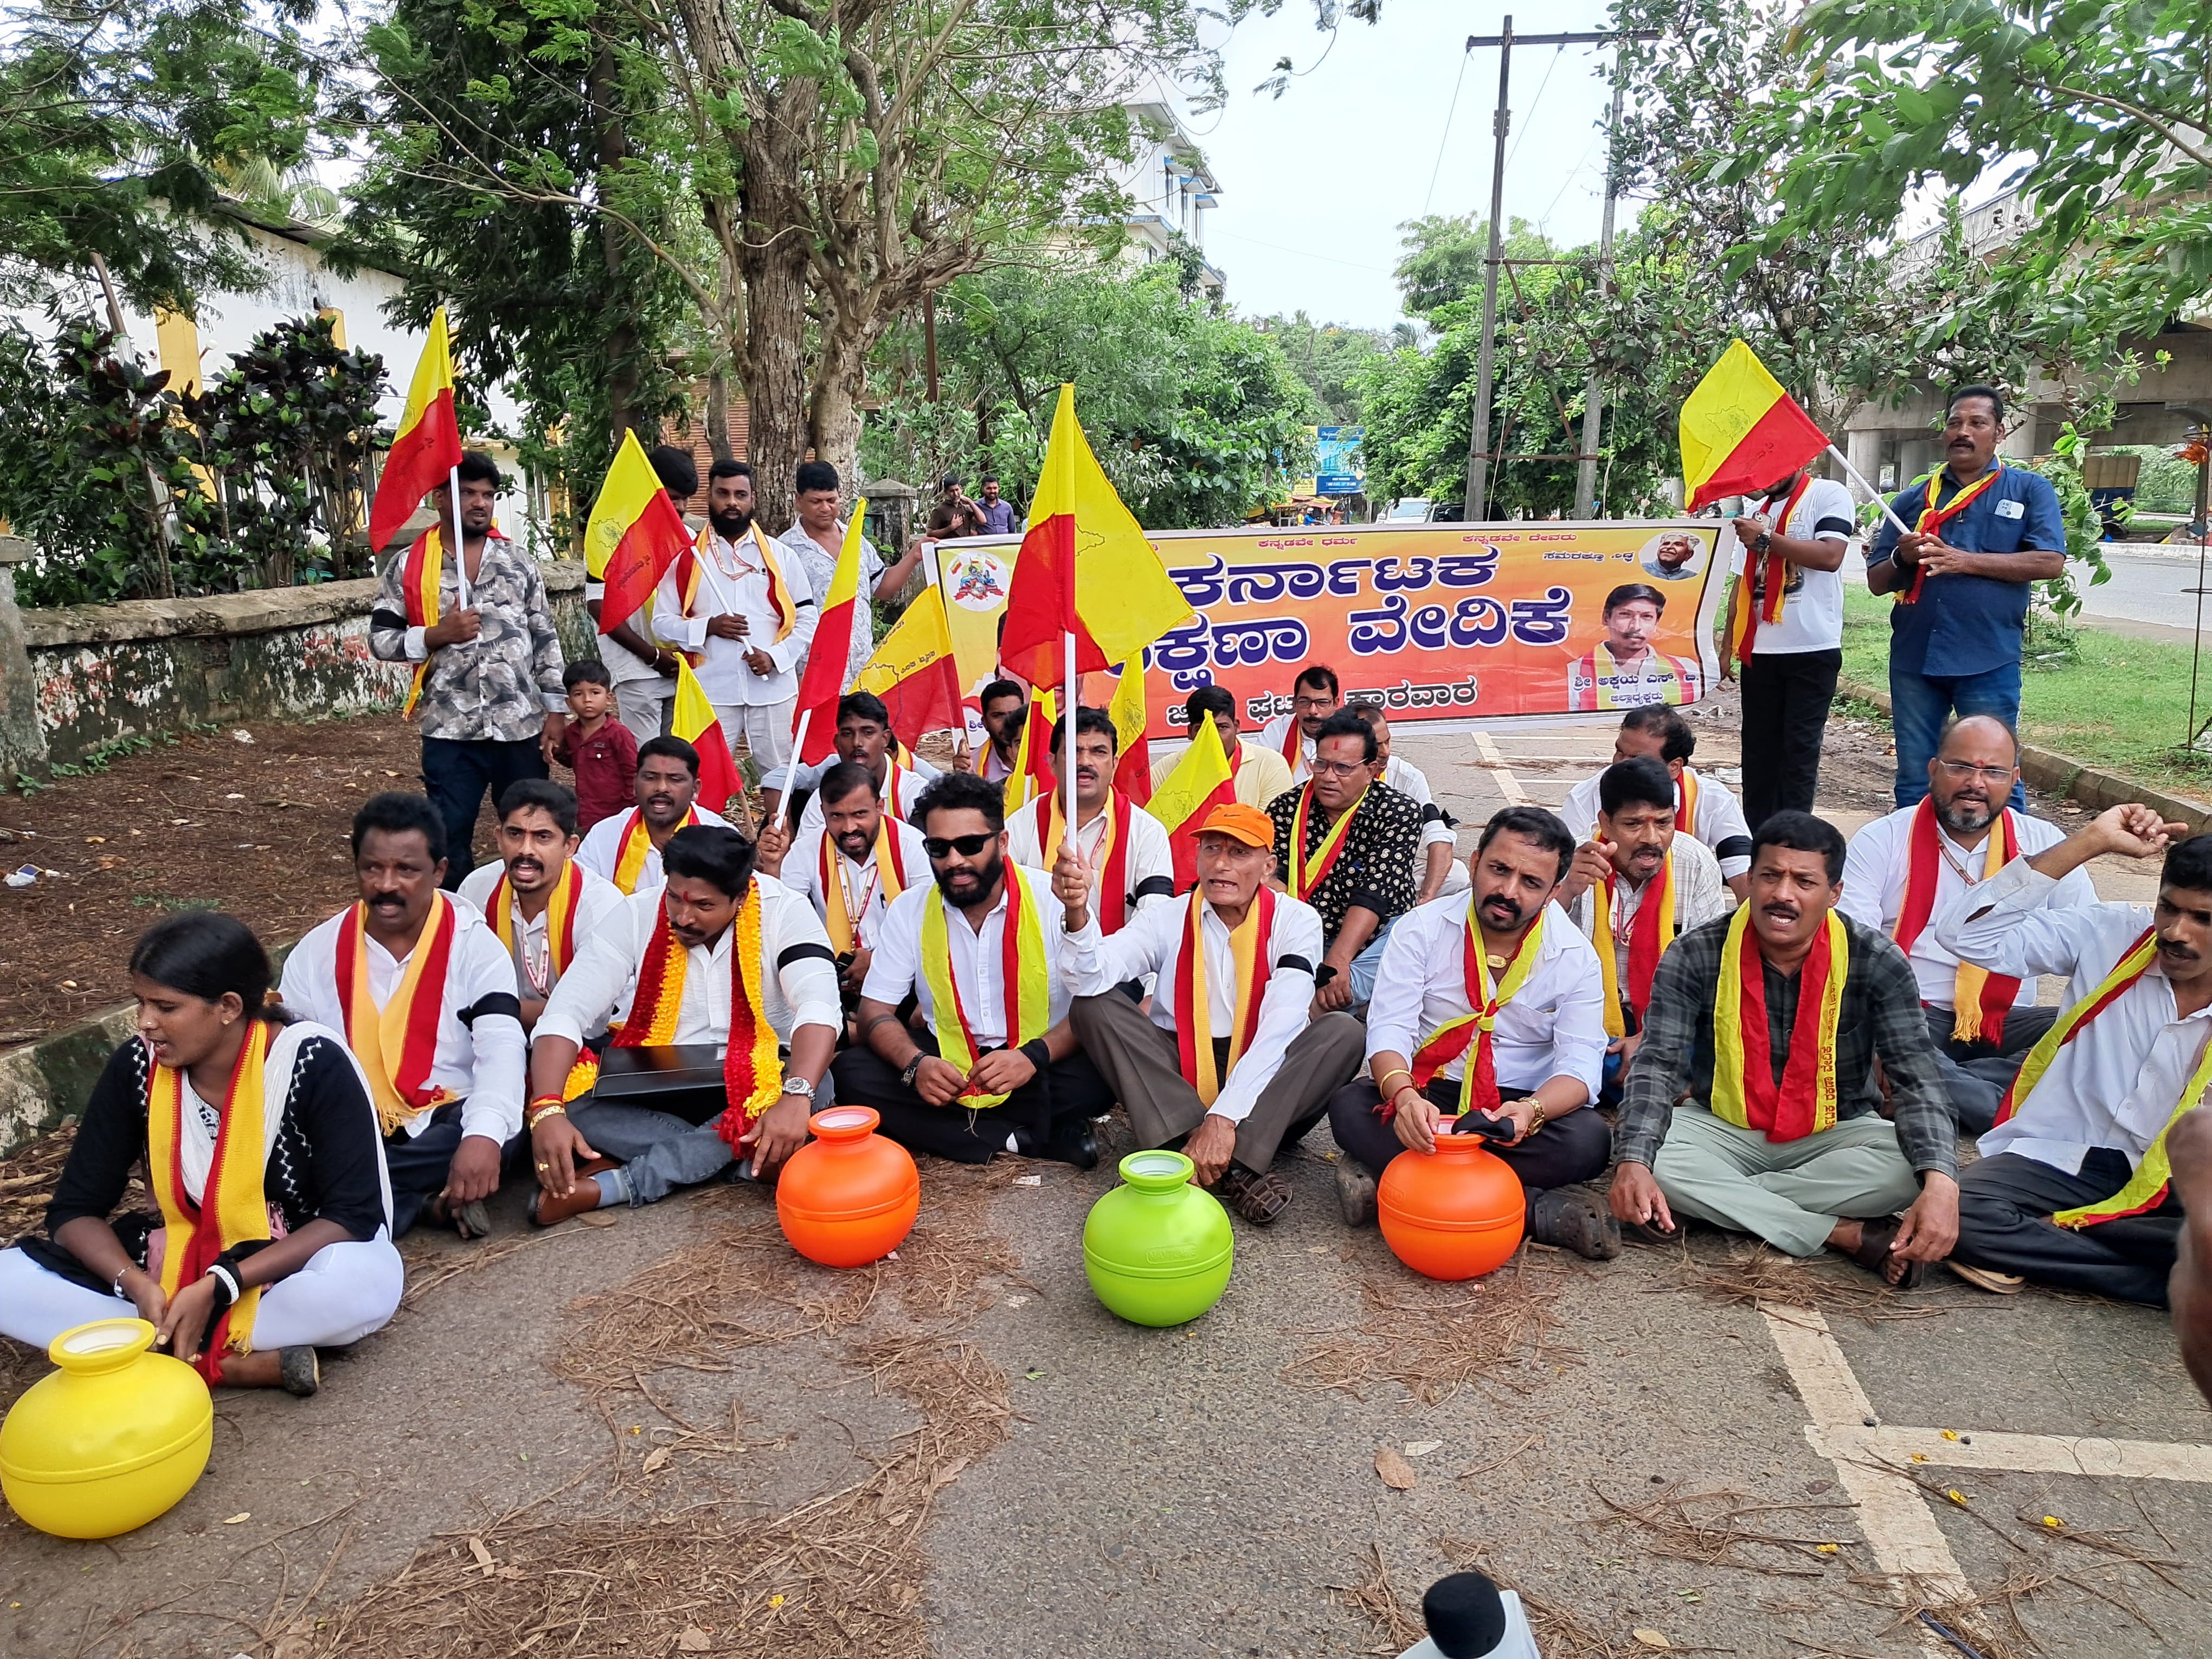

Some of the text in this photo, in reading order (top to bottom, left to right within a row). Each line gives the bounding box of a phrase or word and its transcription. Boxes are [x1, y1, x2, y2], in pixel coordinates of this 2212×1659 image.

[1258, 537, 1358, 550] ಕನ್ನಡವೇ ಧರ್ಮ
[1529, 533, 1577, 542] ದೇವರು
[1168, 545, 1500, 607] ಕರ್ನಾಟಕ
[1350, 587, 1571, 653] ವೇದಿಕೆ
[1573, 676, 1591, 691] ಶ್ರೀ
[1598, 674, 1639, 689] ಅಕ್ಷಯ
[1646, 672, 1677, 683] ಎಸ್.
[1248, 691, 1296, 721] ಘಟ
[1610, 691, 1663, 704] ಜಿಲ್ಲಾಧ್ಯಕ್ಷರು
